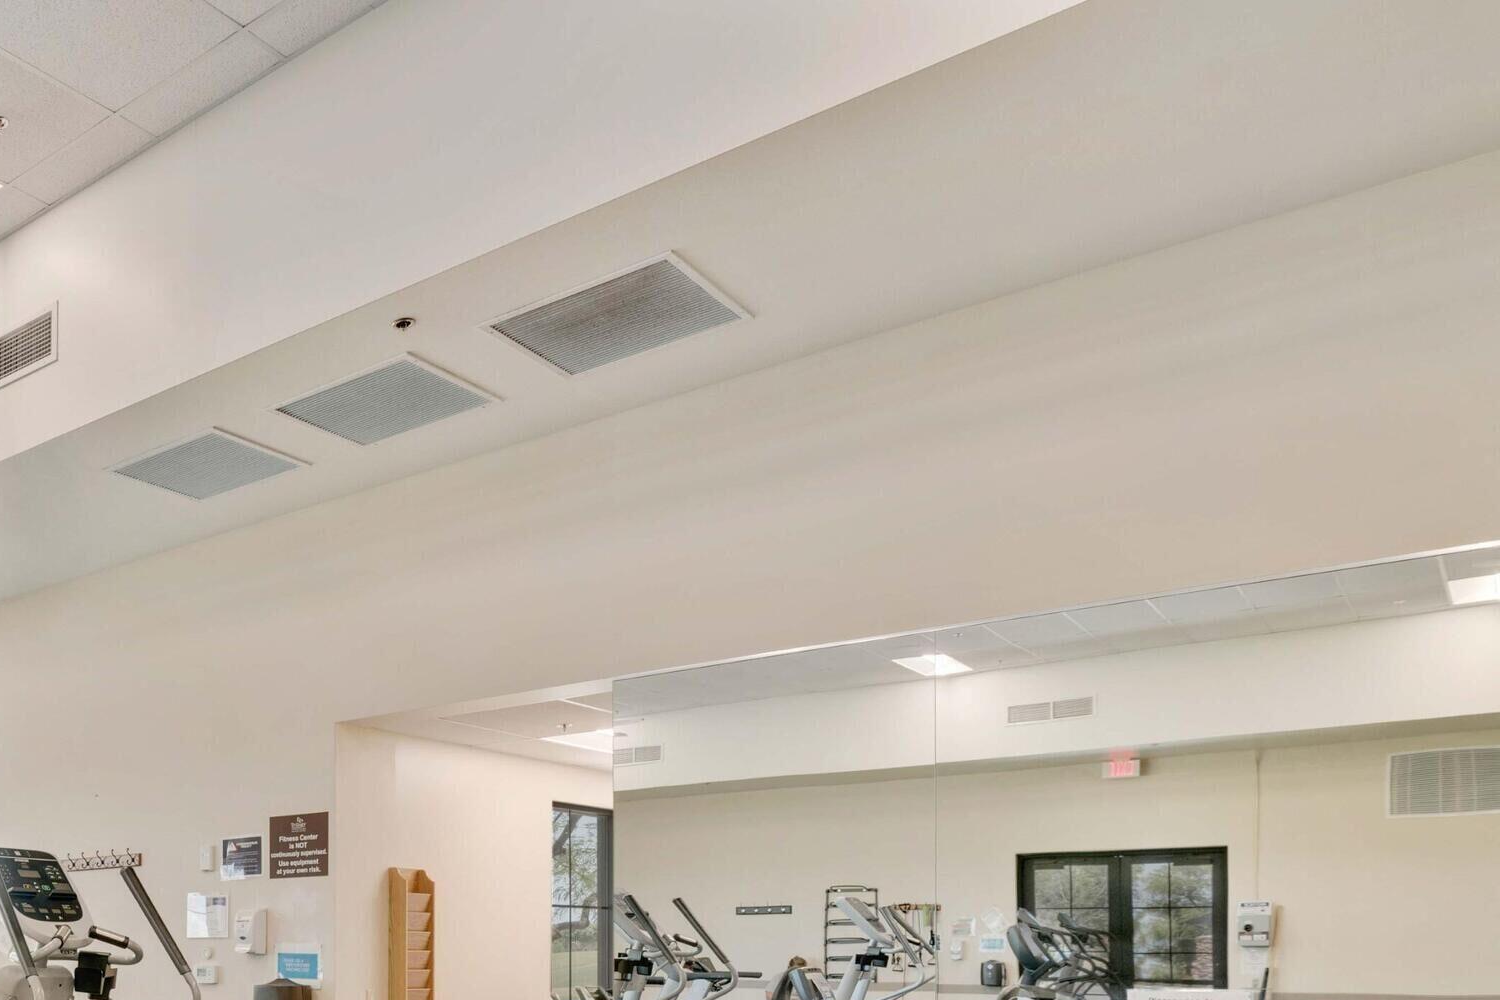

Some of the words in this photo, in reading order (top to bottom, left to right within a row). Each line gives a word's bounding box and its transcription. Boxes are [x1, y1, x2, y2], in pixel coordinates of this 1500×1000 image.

[270, 850, 300, 858] continuously
[300, 848, 327, 857] supervised.
[290, 858, 319, 867] equipment
[282, 868, 296, 876] your
